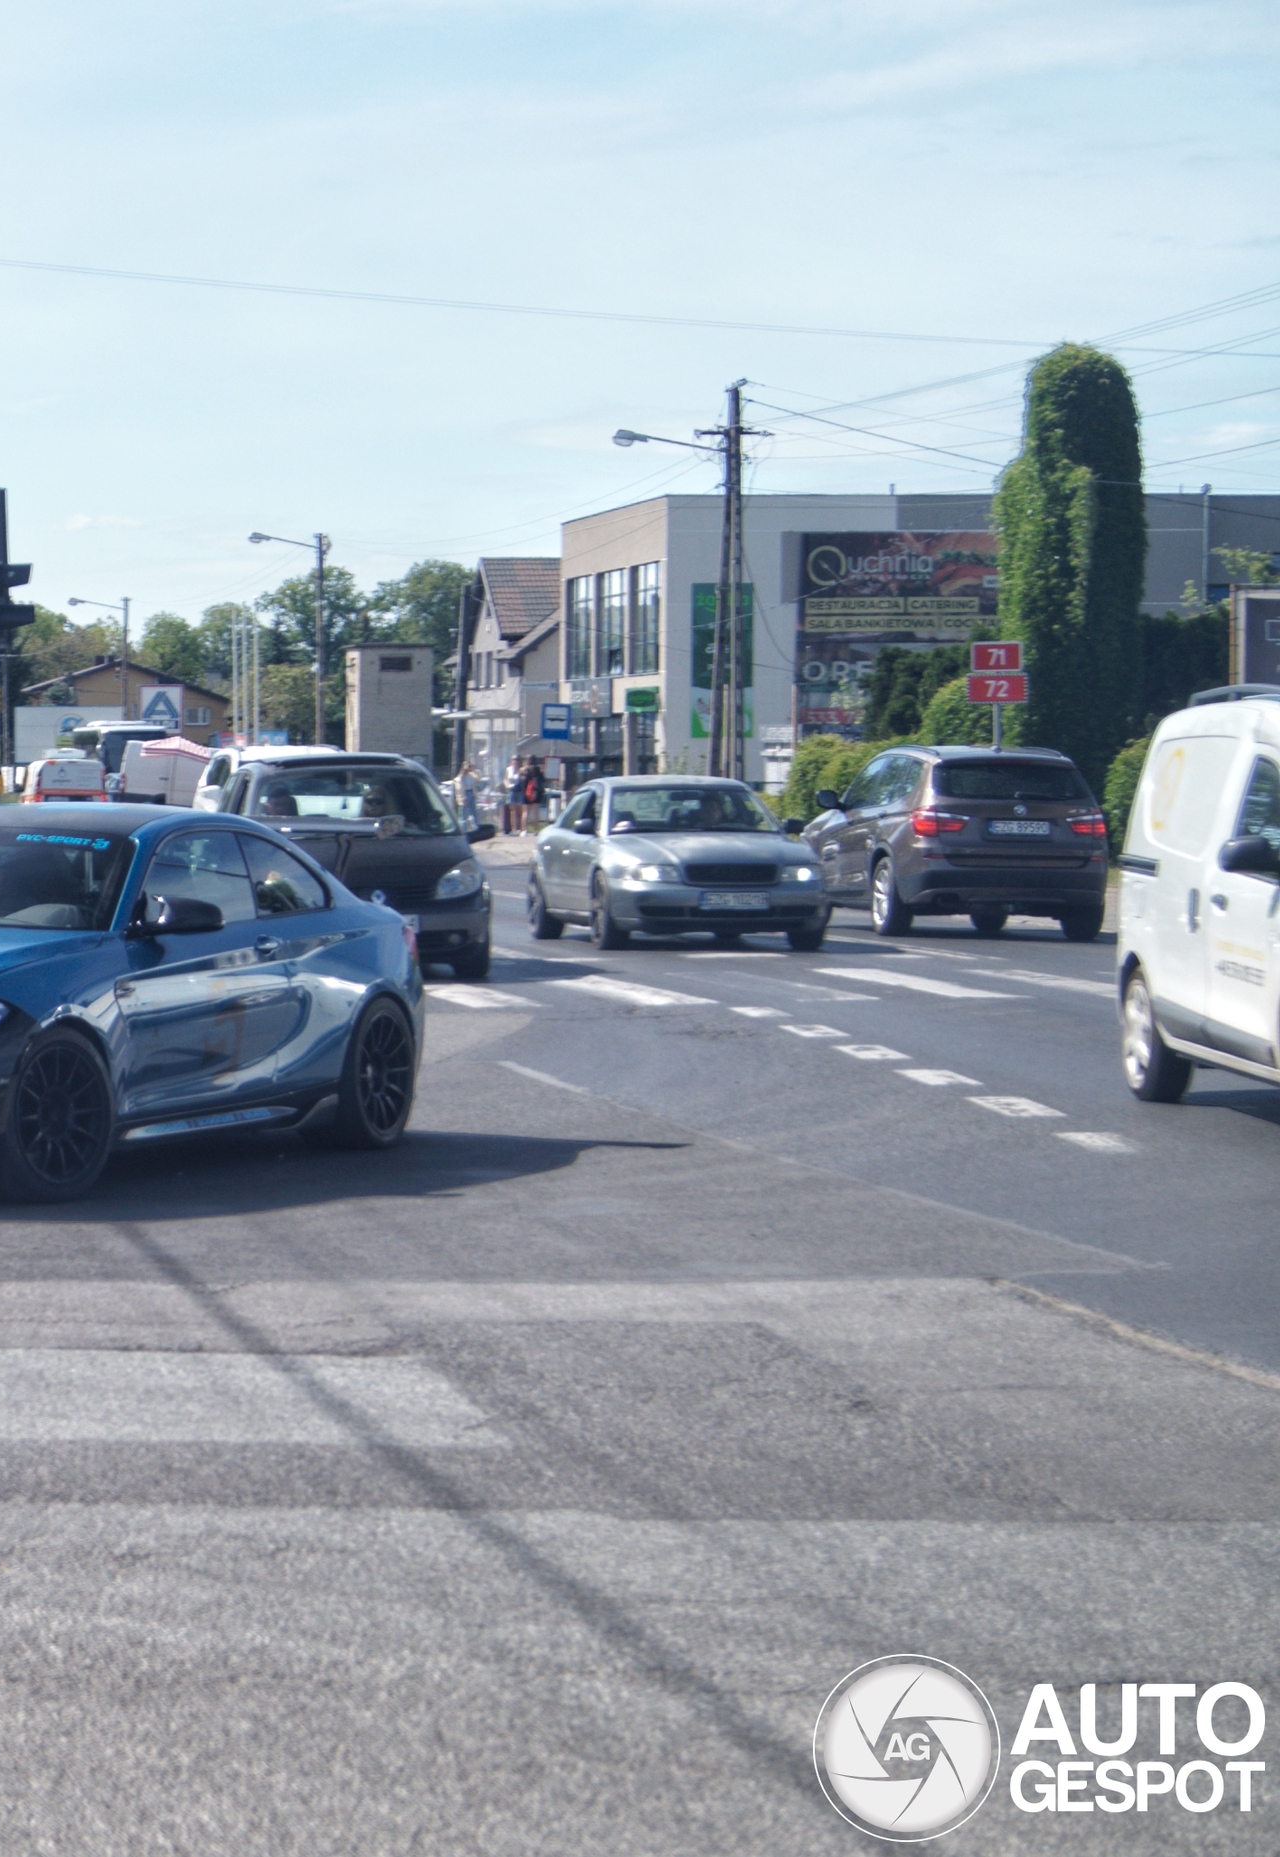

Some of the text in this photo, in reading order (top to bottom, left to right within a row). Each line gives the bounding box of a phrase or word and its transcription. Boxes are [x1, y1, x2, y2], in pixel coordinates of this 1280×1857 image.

[807, 600, 977, 611] RESTAURACJA CATERING
[807, 618, 845, 629] SALA
[847, 618, 934, 629] BANKIETOWA
[987, 648, 1007, 666] 71
[984, 680, 1009, 698] 72
[16, 833, 92, 846] PVC-SPORT
